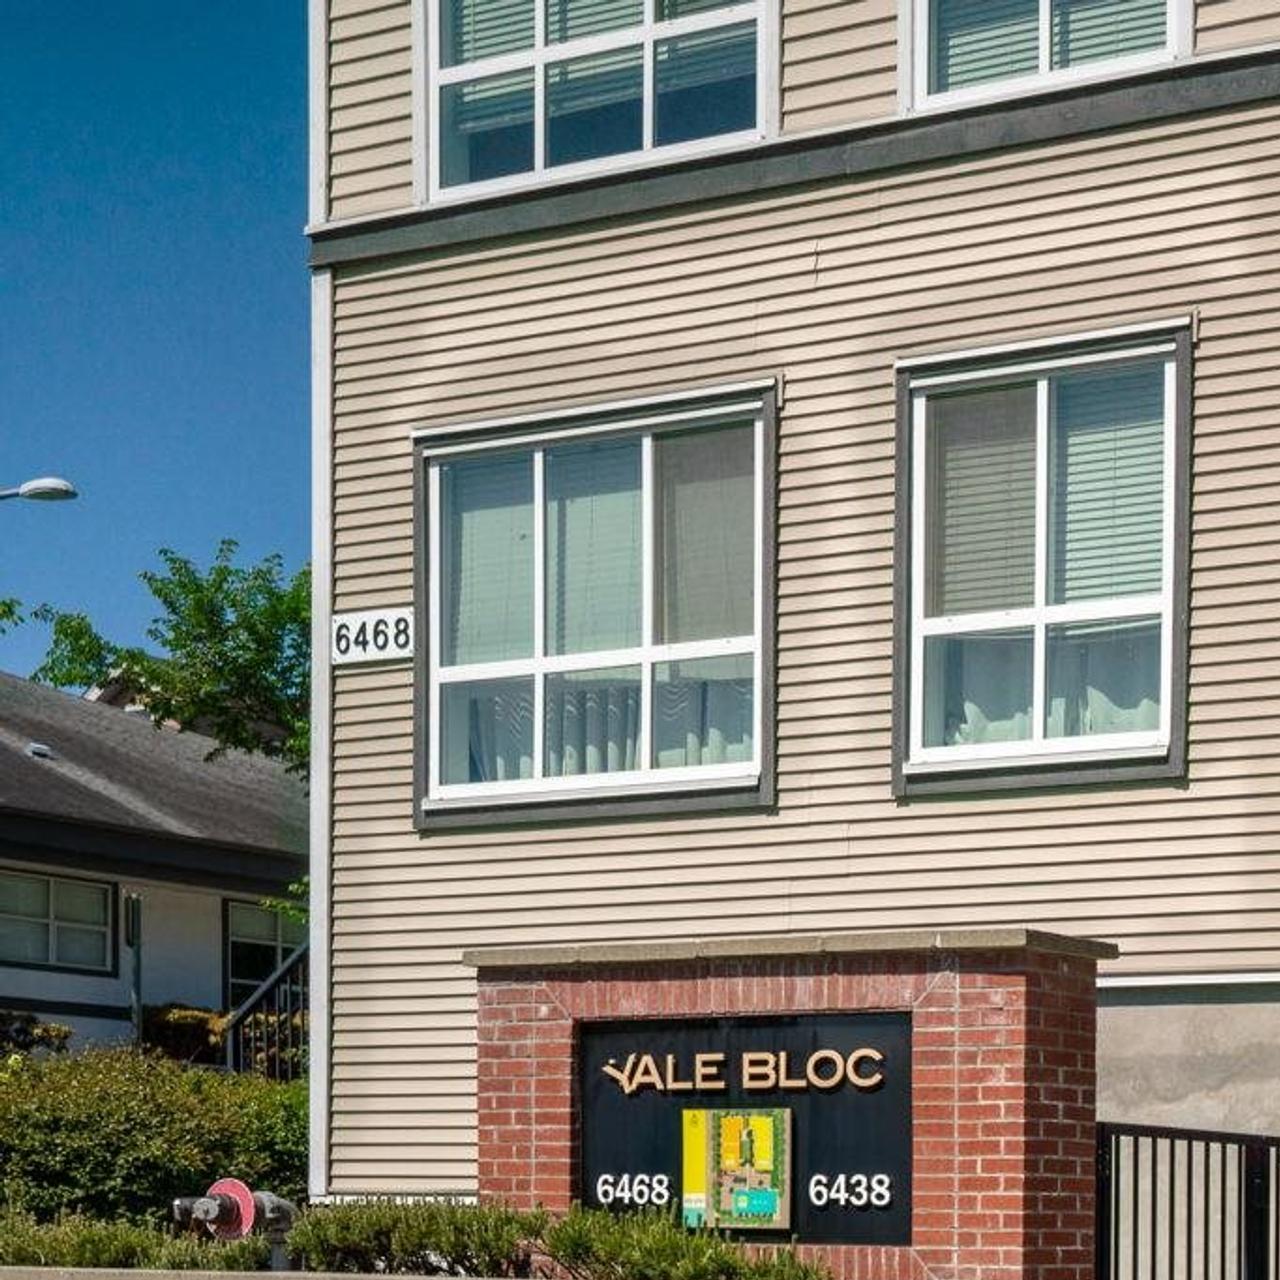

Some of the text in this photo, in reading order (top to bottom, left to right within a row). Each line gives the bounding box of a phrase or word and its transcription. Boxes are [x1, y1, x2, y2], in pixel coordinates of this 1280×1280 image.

[336, 617, 410, 655] 6468
[742, 1048, 884, 1089] BLOC
[596, 1174, 669, 1205] 6468
[808, 1173, 891, 1207] 6438
